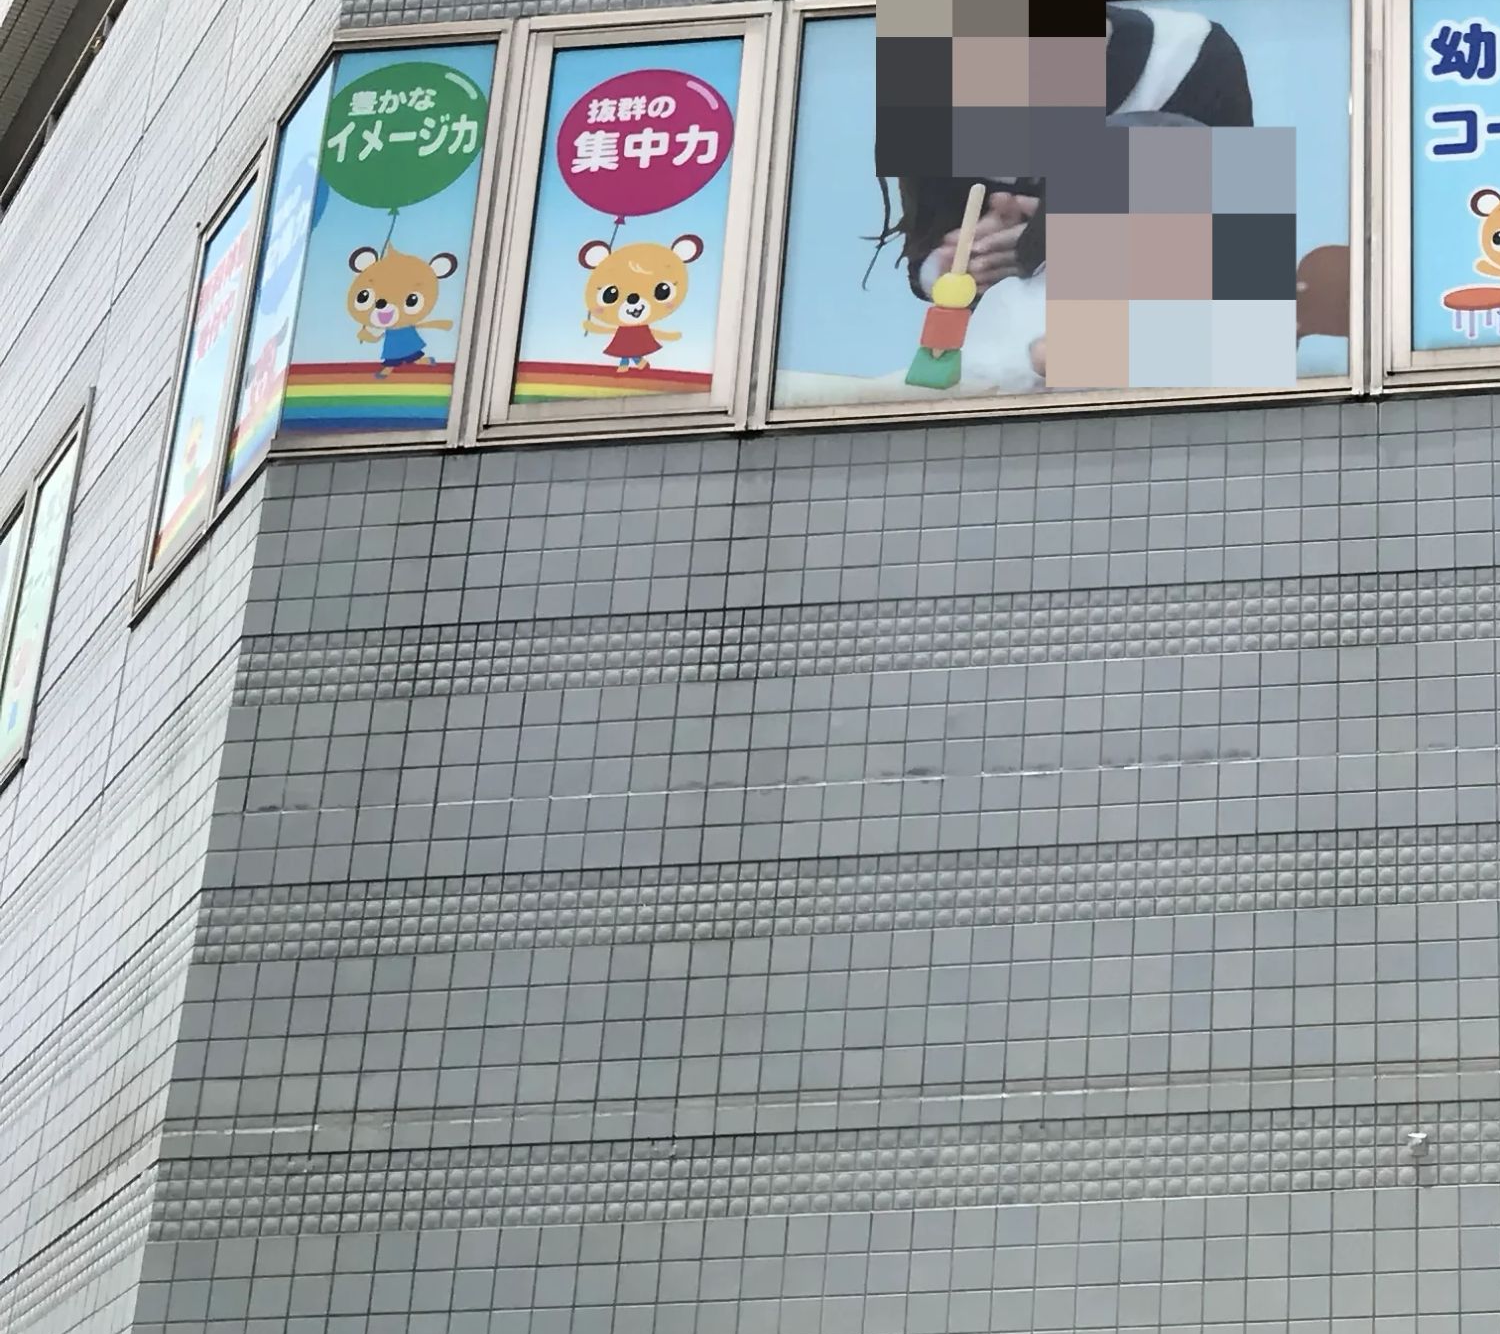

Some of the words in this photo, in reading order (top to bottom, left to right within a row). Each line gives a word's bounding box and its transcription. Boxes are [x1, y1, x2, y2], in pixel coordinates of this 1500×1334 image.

[348, 86, 437, 118] 豊かな
[587, 94, 676, 125] 抜群の
[326, 113, 480, 165] イメージ力
[570, 124, 720, 174] 集中力
